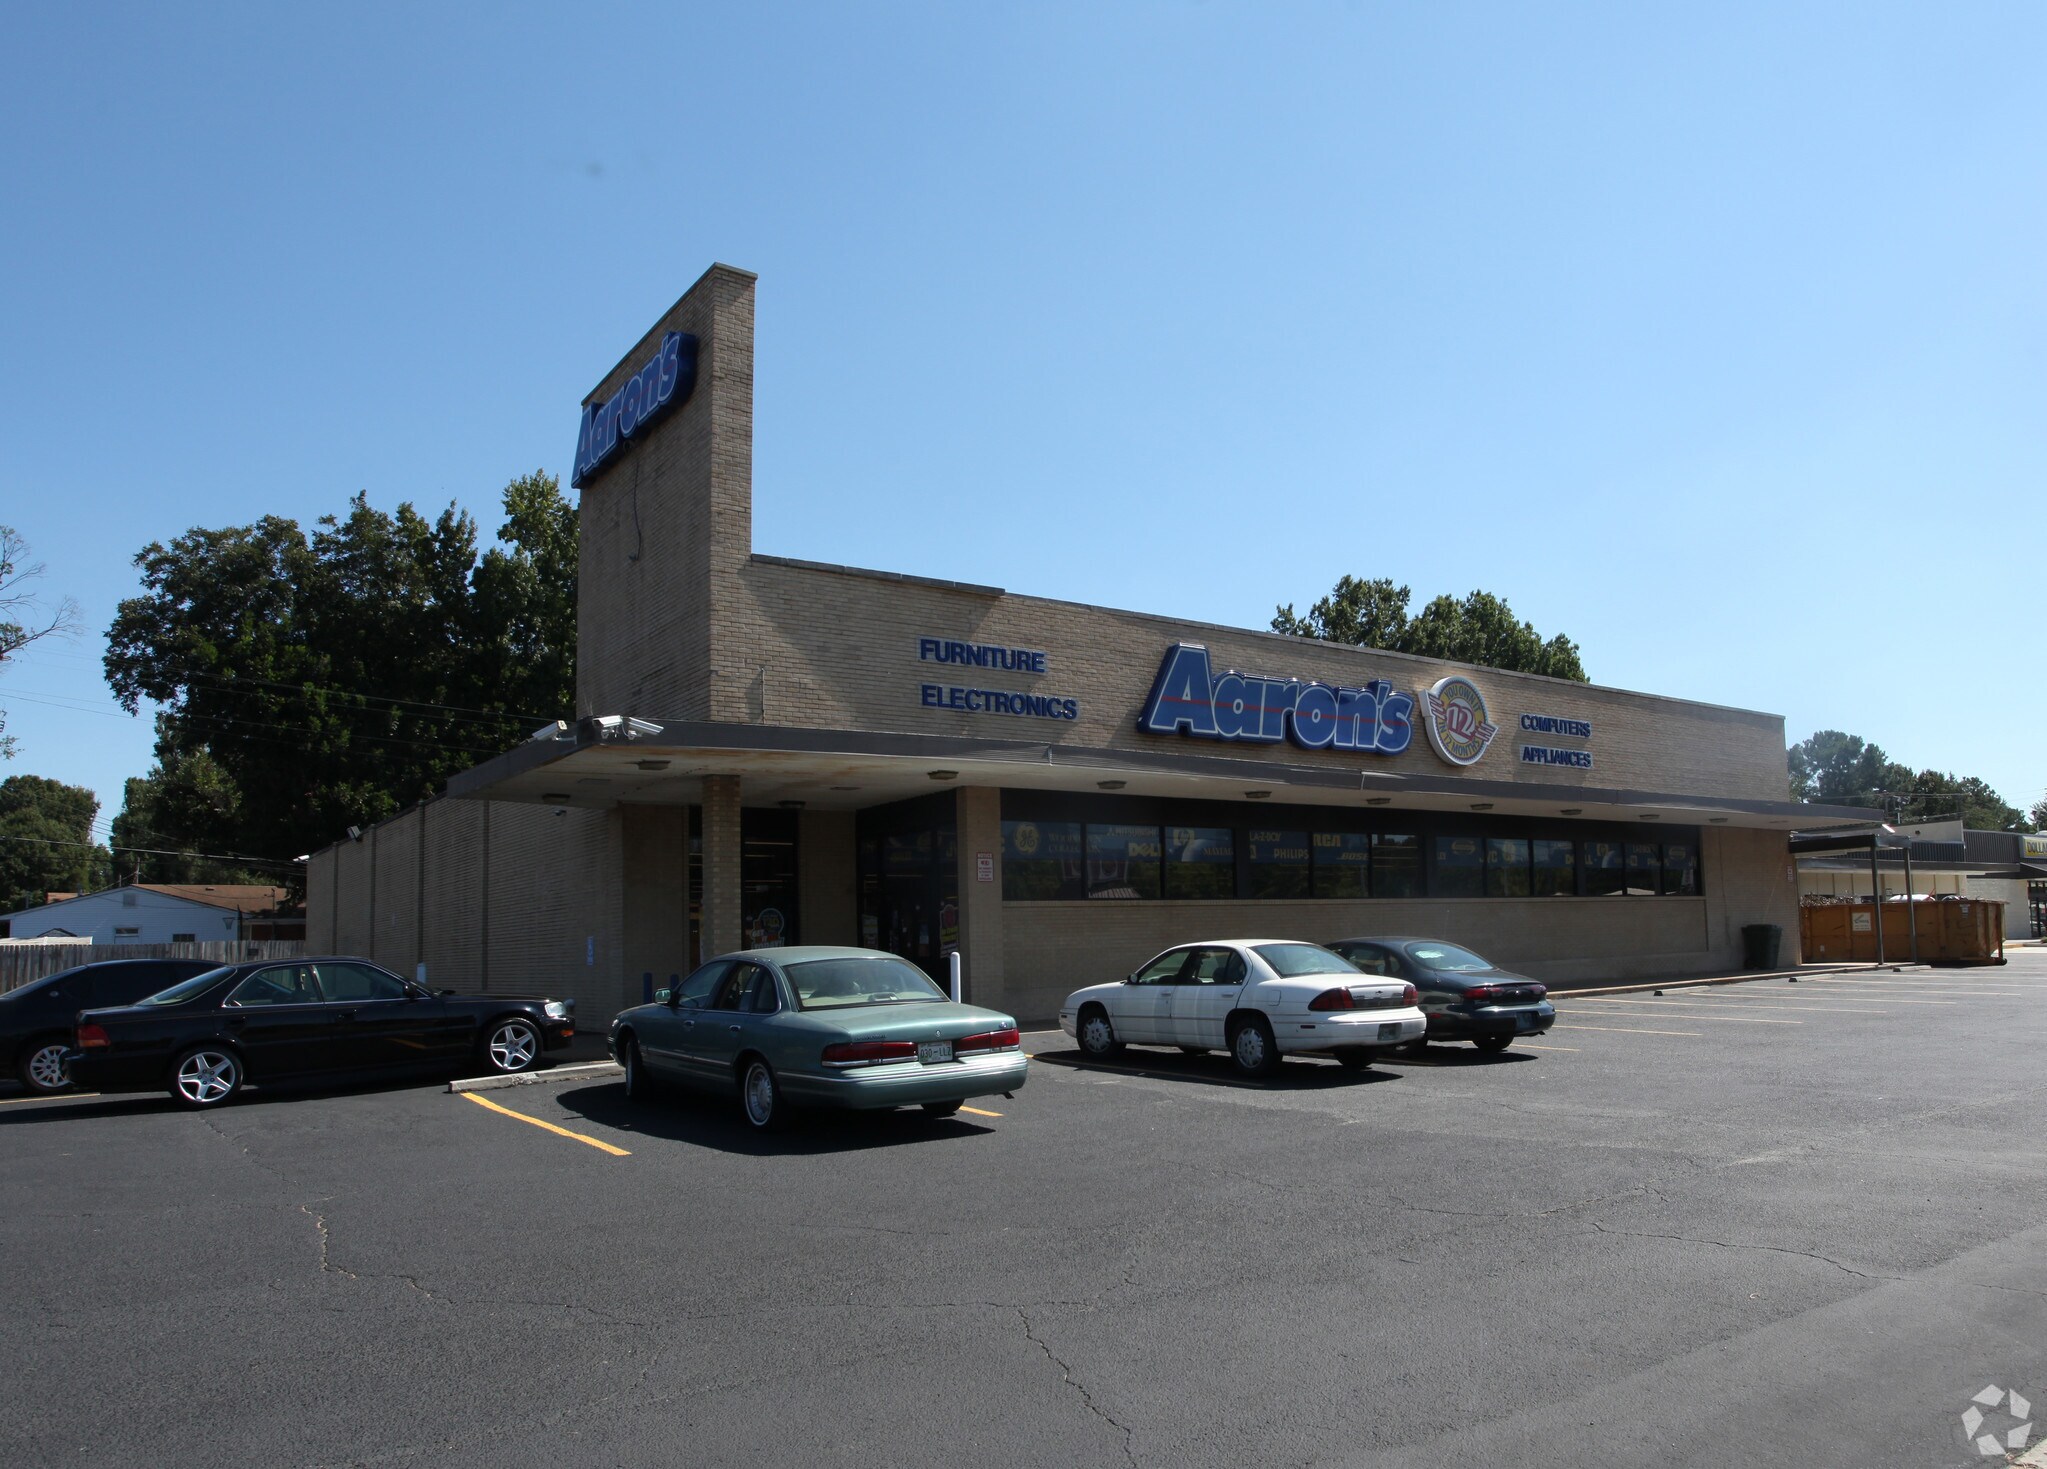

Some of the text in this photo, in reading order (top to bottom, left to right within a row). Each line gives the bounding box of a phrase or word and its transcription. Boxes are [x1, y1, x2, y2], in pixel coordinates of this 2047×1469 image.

[571, 334, 681, 487] Aaron's
[921, 638, 1045, 673] FURNITURE
[922, 685, 1077, 719] ELECTRONICS
[1143, 646, 1415, 756] Aaron's
[1444, 685, 1480, 712] YOU OWN IT
[1438, 722, 1480, 756] IN 12 MONTHS
[1446, 703, 1475, 741] 12
[1521, 714, 1591, 737] COMPUTERS
[1523, 746, 1591, 767] APPLIANCES
[1273, 848, 1309, 860] PHILIPS
[1312, 833, 1341, 847] RCA
